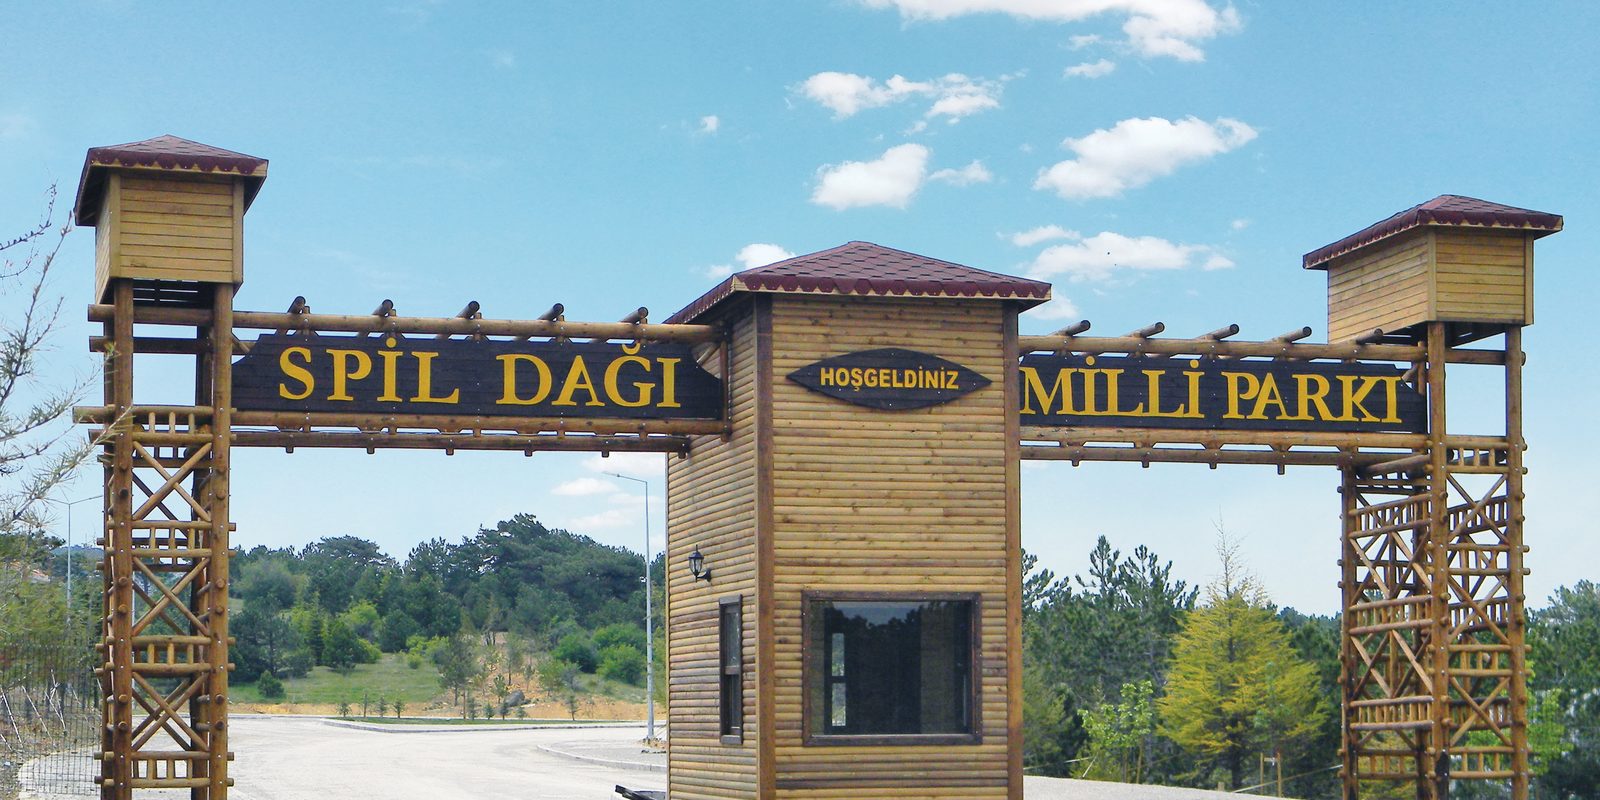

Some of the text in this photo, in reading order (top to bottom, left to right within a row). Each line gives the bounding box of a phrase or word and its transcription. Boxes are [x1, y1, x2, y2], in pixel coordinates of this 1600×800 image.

[279, 337, 681, 408] SPİL DAĞI
[820, 365, 959, 392] HOŞGELDİNİZ
[1020, 355, 1403, 424] MİLLİ PARKI
